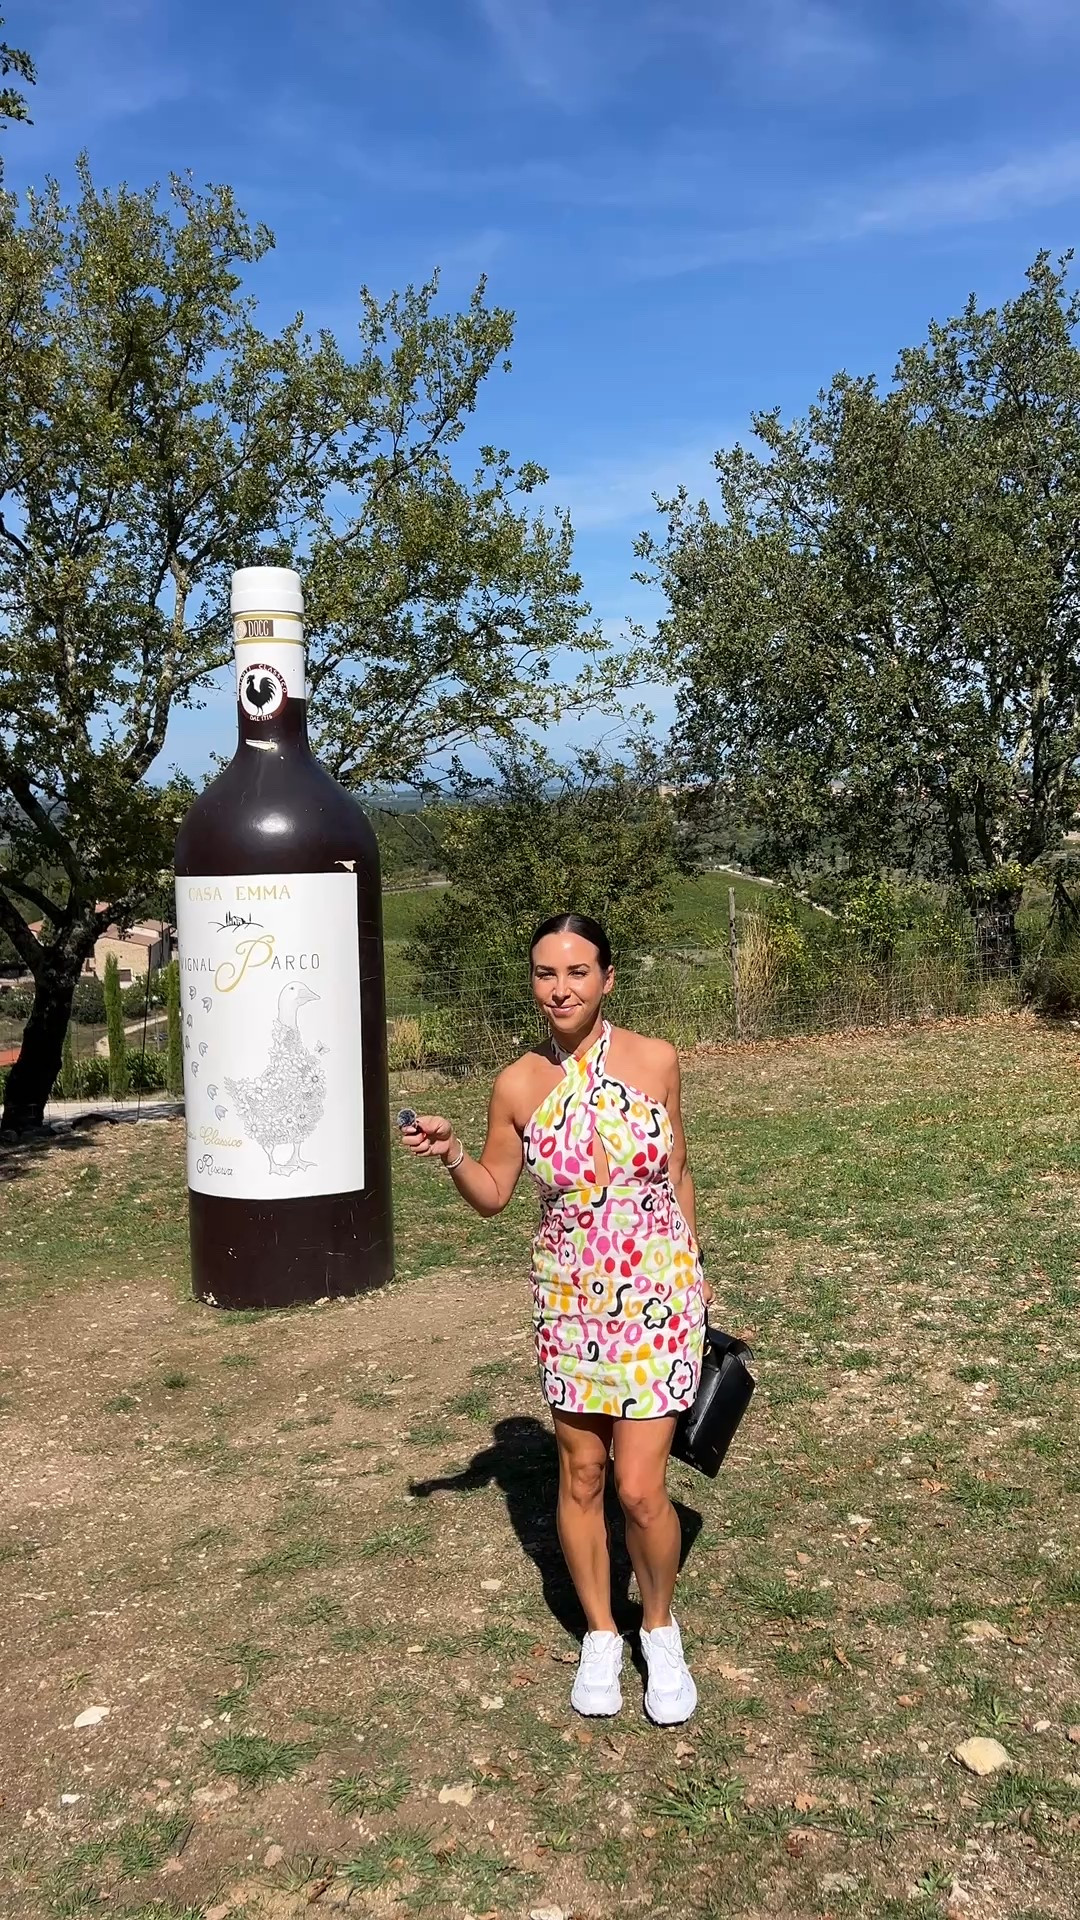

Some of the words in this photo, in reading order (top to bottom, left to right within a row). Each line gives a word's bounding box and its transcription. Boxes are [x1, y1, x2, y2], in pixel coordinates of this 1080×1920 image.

[248, 620, 269, 637] DOCG
[258, 664, 288, 693] CLASSICO
[188, 887, 222, 902] CASA
[235, 885, 291, 901] EMMA
[199, 1126, 243, 1148] Classico
[196, 1153, 233, 1176] Riserva
